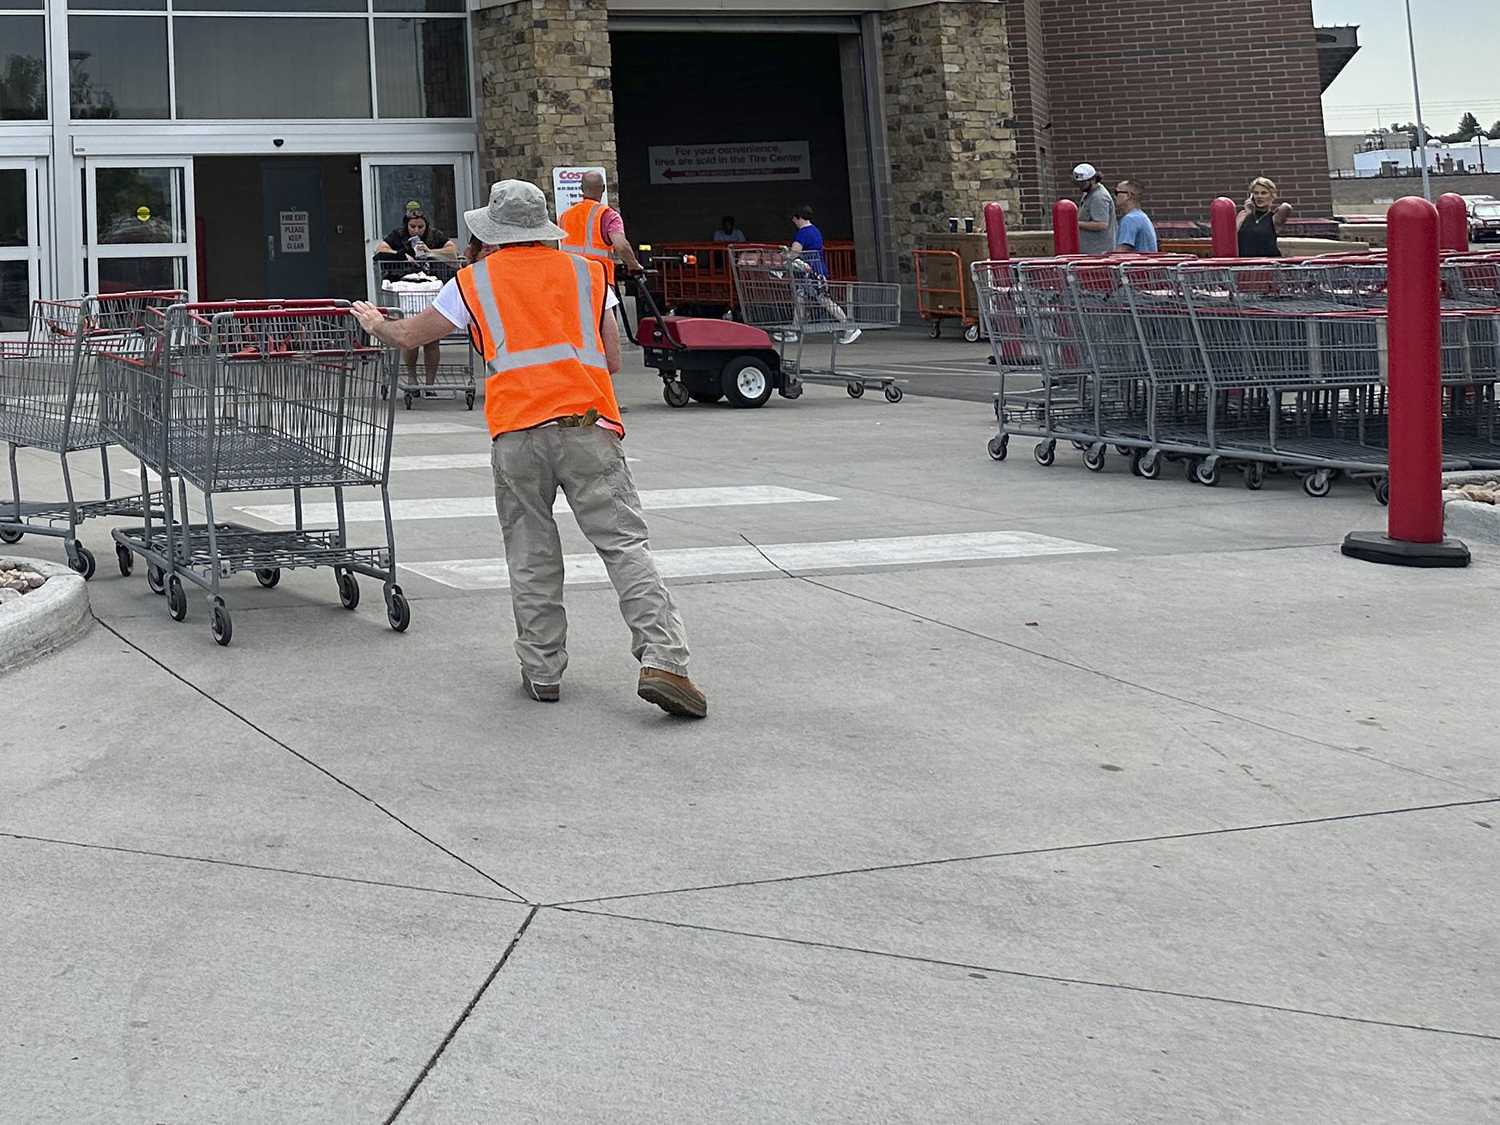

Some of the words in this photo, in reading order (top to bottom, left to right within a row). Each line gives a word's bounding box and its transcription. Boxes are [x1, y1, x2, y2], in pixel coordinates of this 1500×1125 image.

[675, 147, 690, 156] For
[693, 147, 715, 158] your
[655, 157, 676, 166] tires
[696, 156, 716, 165] sold
[718, 155, 728, 164] in
[729, 155, 746, 164] the
[748, 154, 767, 164] Tire
[288, 234, 302, 242] KEEP
[286, 242, 305, 250] CLEAR
